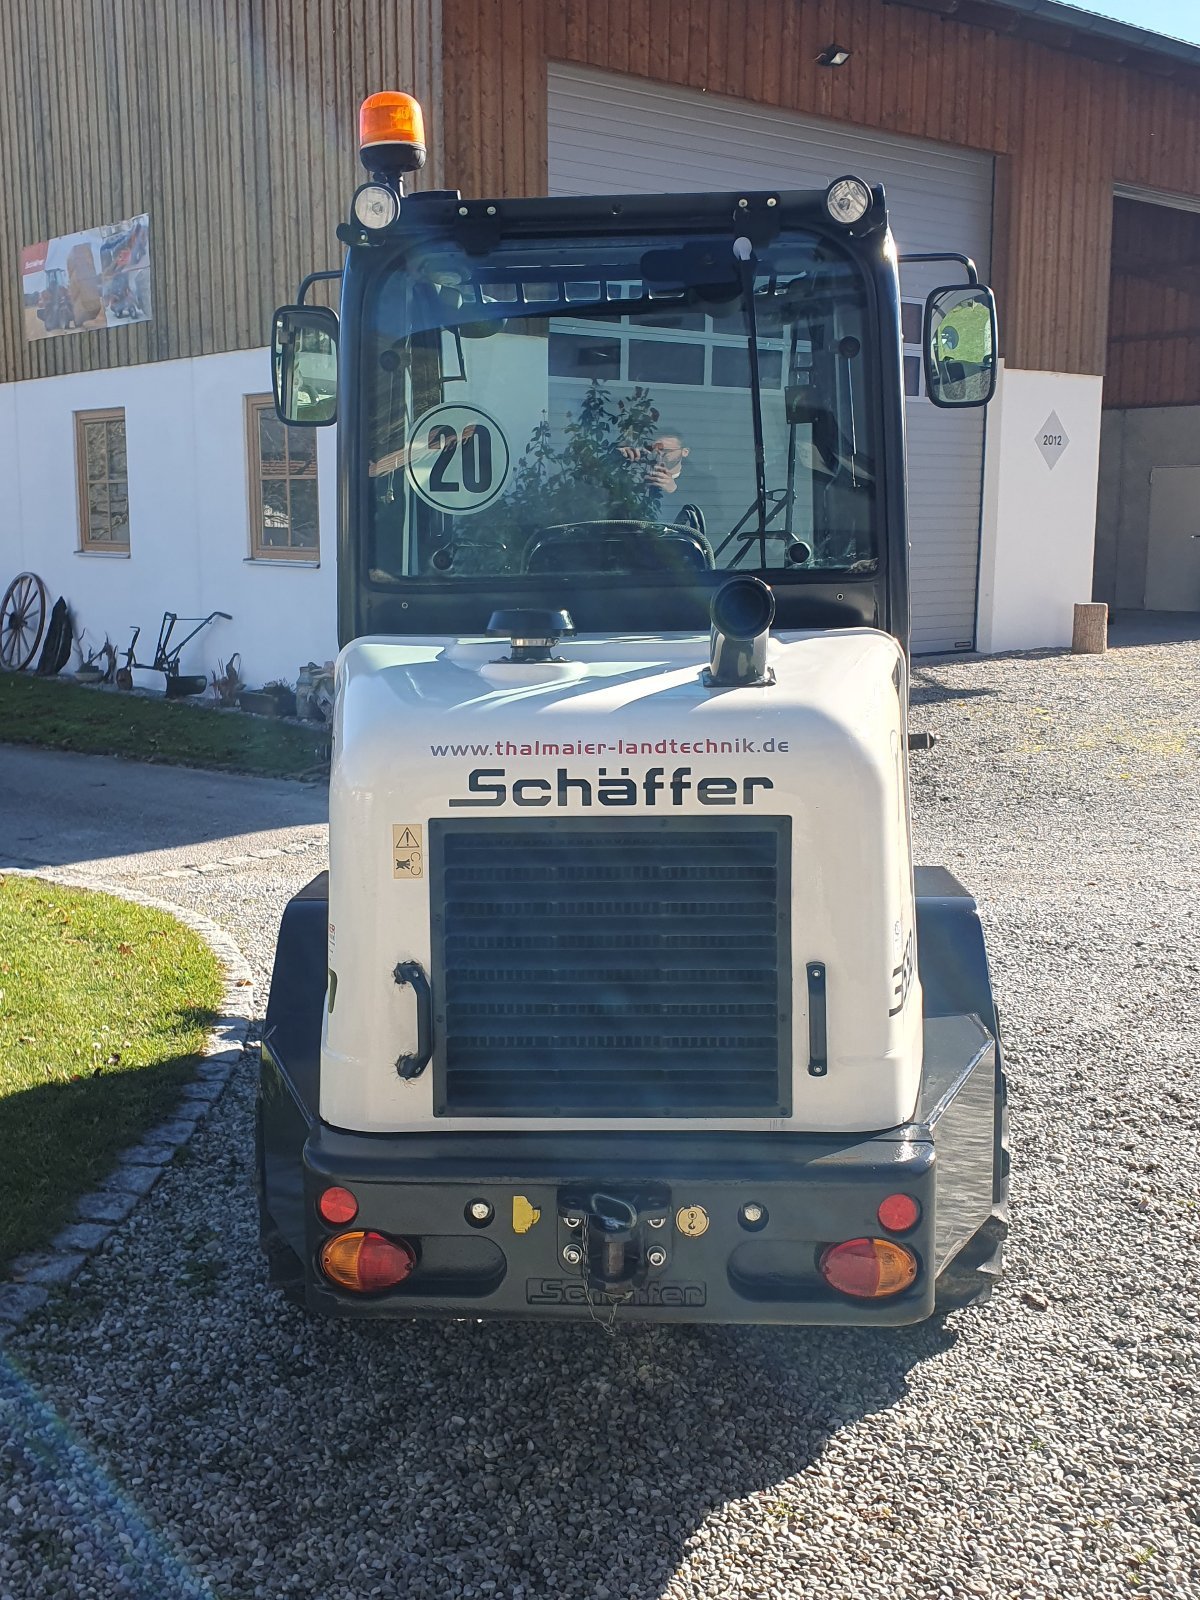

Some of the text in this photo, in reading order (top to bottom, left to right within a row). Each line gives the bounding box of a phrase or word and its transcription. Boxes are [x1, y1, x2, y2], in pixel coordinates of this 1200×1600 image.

[1042, 434, 1063, 446] 2012
[428, 424, 493, 494] 20
[430, 737, 790, 757] www.thalmaier-landtechnik.de
[448, 767, 774, 808] Schäffer
